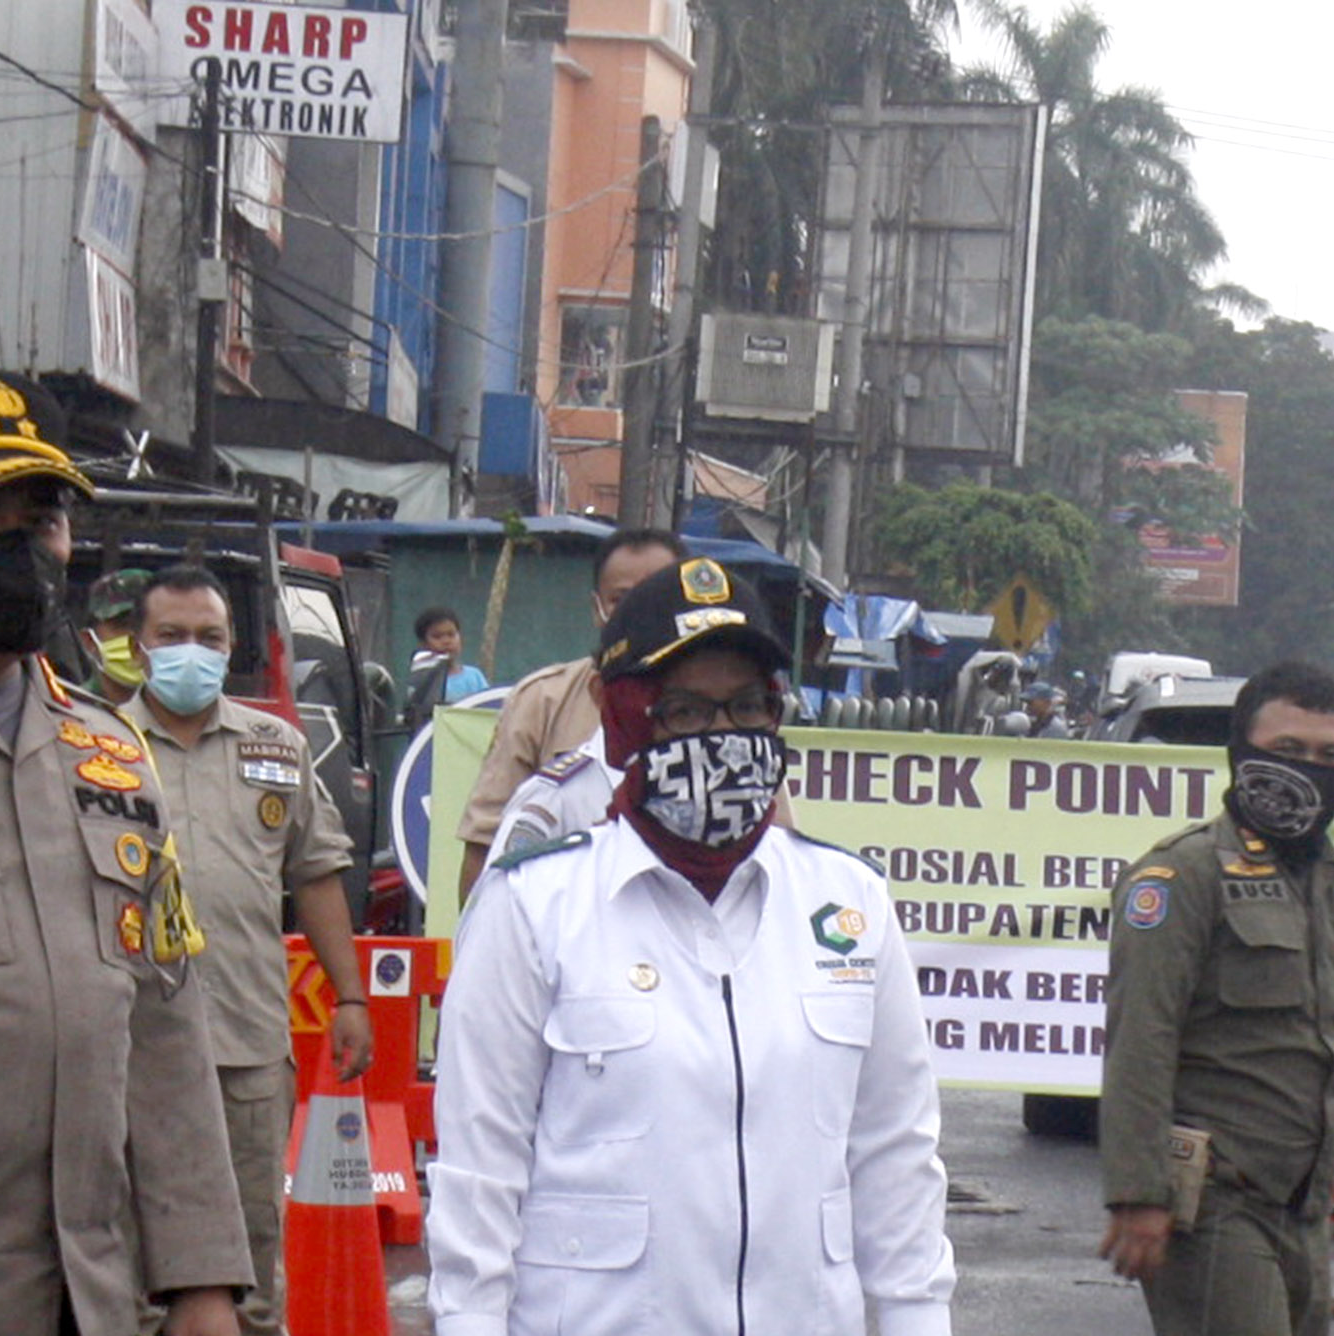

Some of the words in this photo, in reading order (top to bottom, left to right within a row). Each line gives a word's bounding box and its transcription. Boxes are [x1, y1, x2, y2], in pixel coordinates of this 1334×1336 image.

[184, 5, 368, 61] SHARP
[189, 55, 373, 100] OMEGA
[786, 749, 982, 809] CHECK
[1009, 759, 1215, 820] POINT
[895, 900, 1110, 941] BUPATEN
[925, 1018, 965, 1050] G
